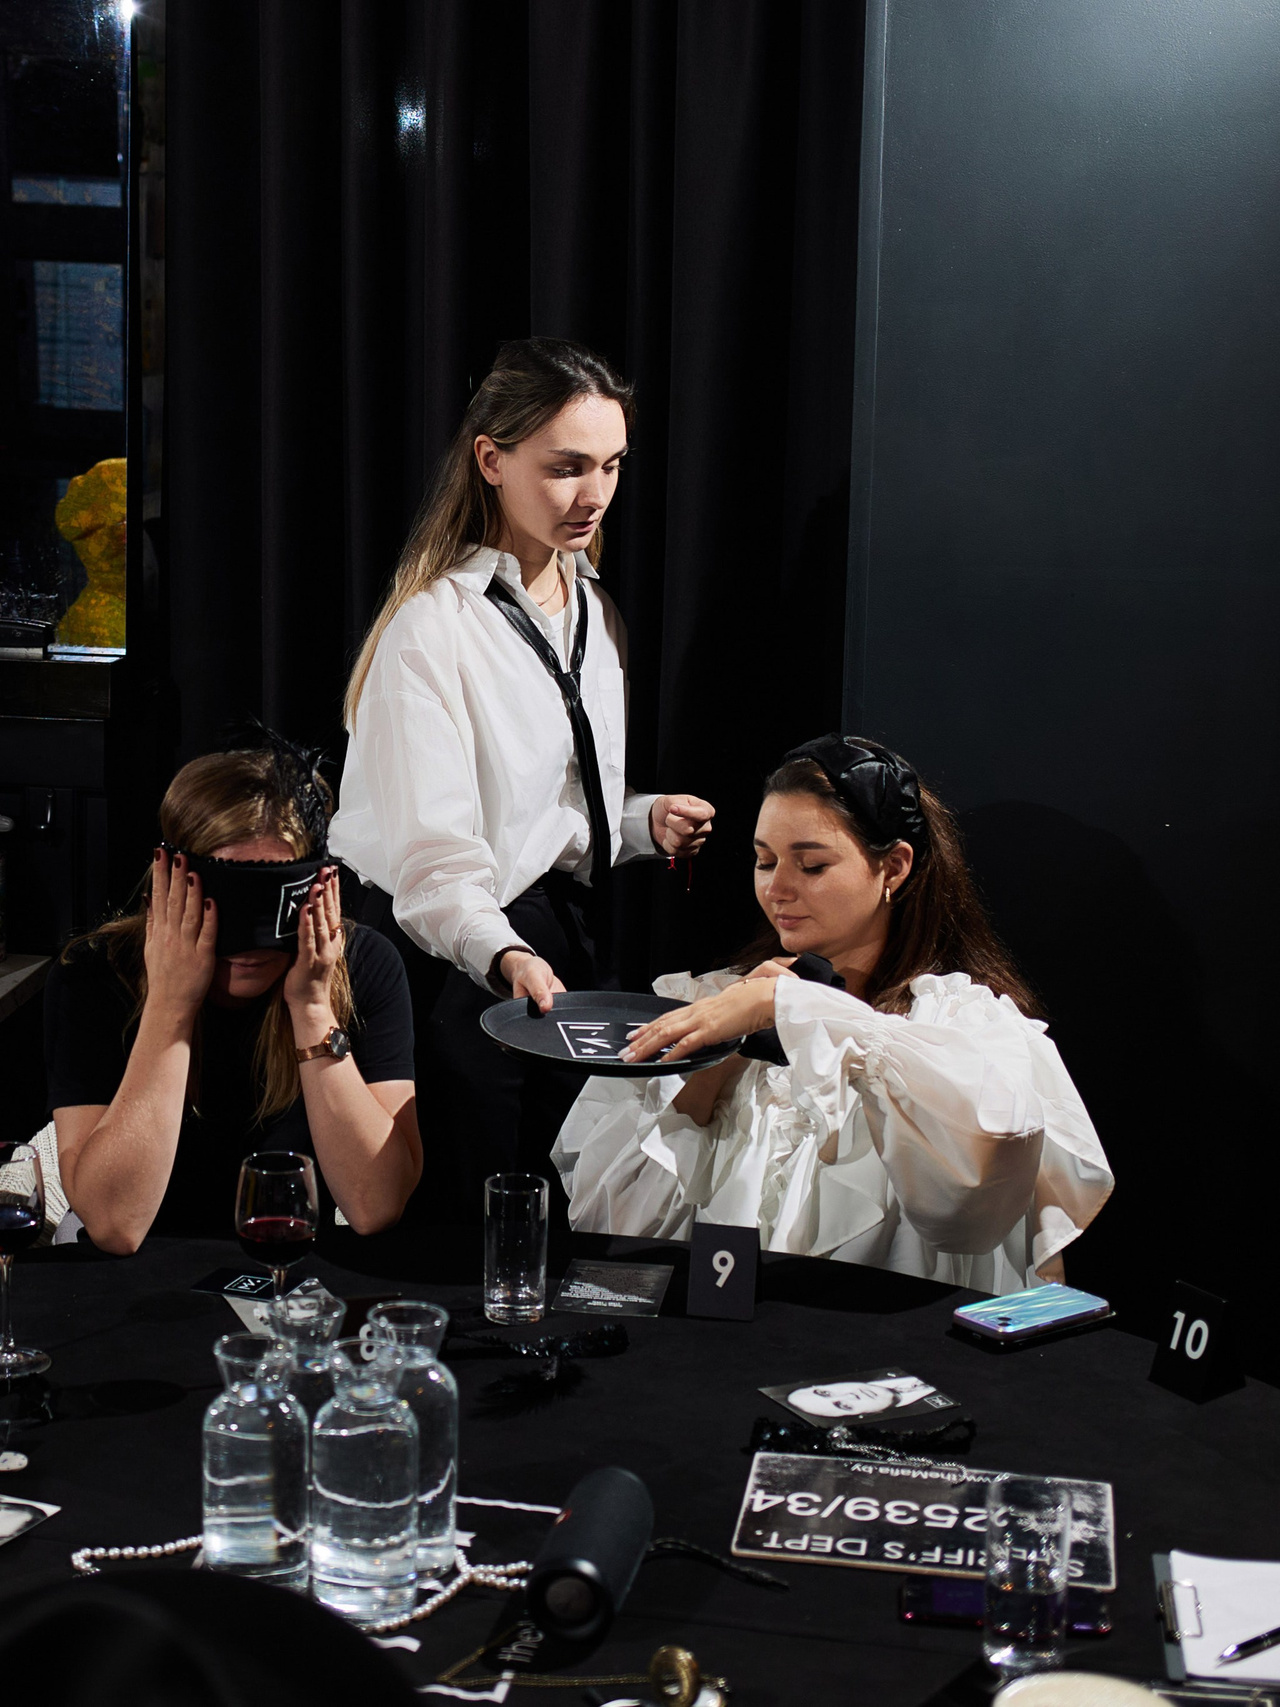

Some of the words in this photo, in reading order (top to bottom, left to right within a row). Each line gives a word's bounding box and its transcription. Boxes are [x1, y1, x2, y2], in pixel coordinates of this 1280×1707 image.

[712, 1249, 736, 1290] 9
[358, 1323, 378, 1361] 8
[1168, 1310, 1211, 1362] 10
[754, 1529, 869, 1557] DEPT.
